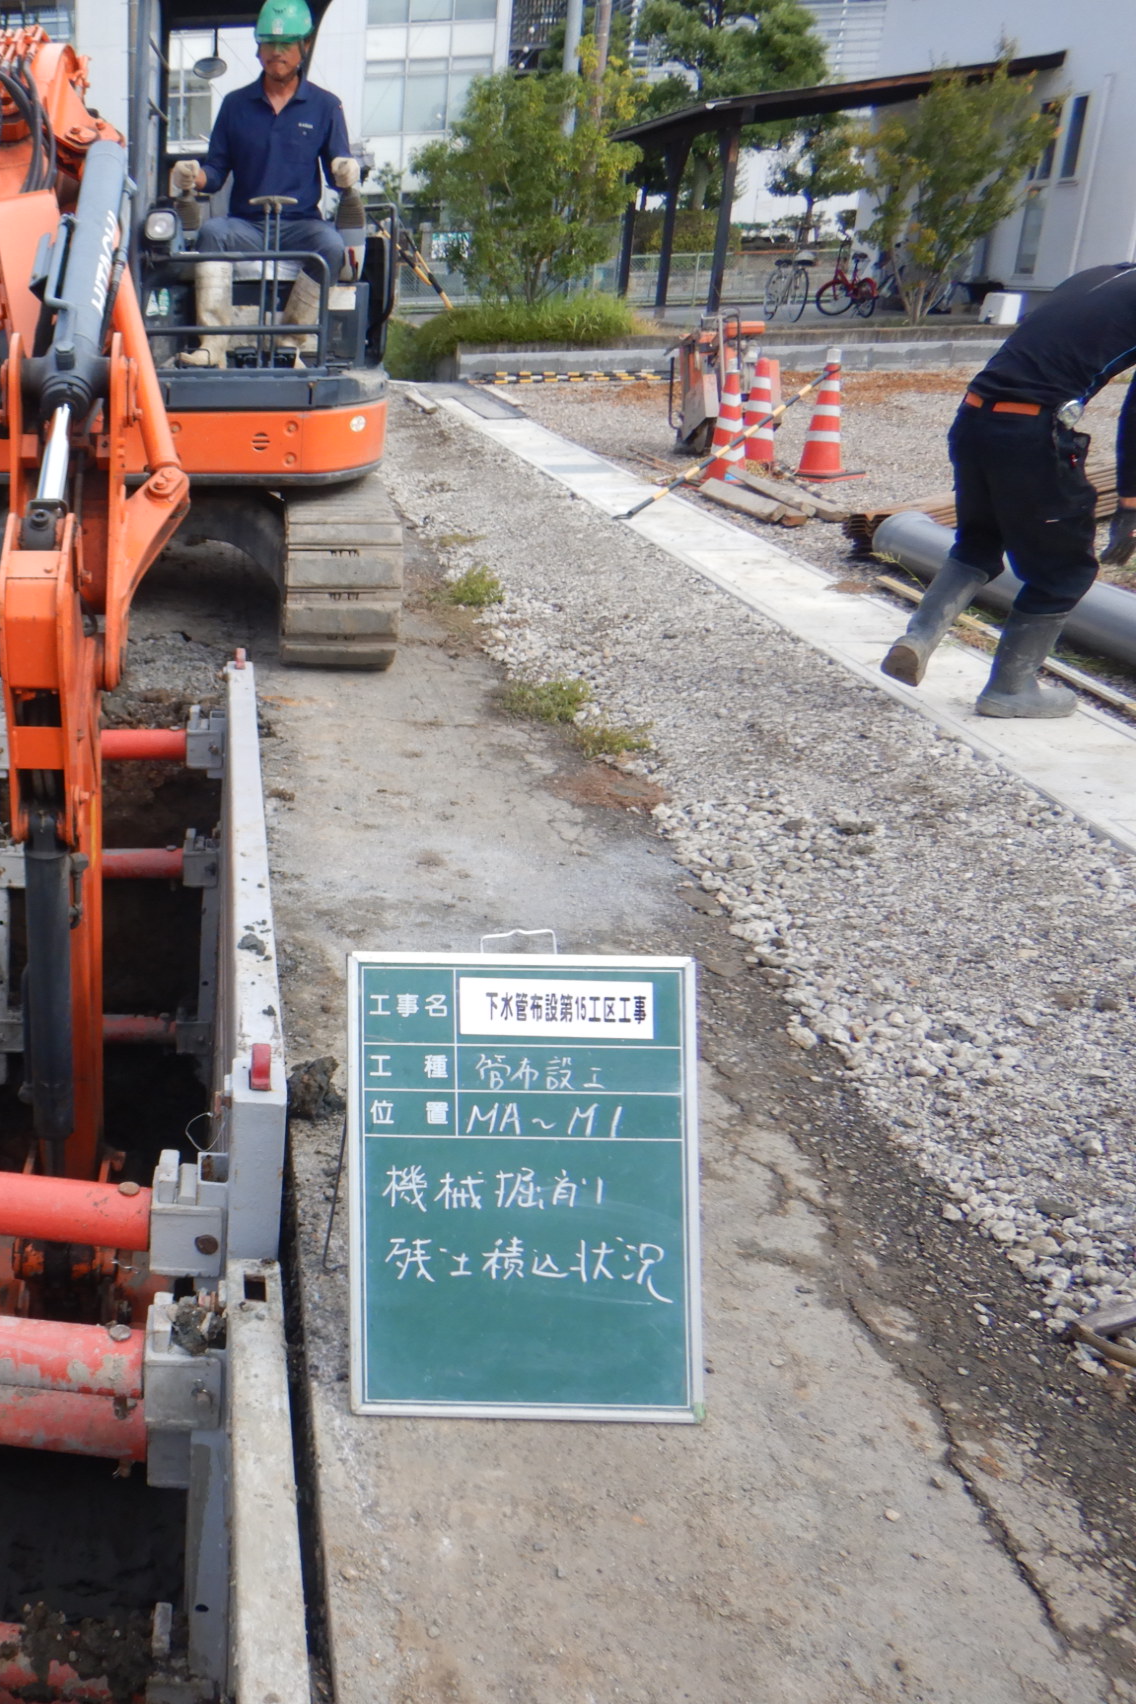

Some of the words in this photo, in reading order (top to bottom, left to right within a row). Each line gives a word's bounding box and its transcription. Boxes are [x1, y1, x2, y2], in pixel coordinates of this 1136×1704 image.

[369, 993, 448, 1017] 工事名
[486, 991, 646, 1024] 下水管布設第15工区工事
[369, 1054, 448, 1078] 工種
[370, 1099, 448, 1124] 位置
[382, 1165, 603, 1212] 機械掘削
